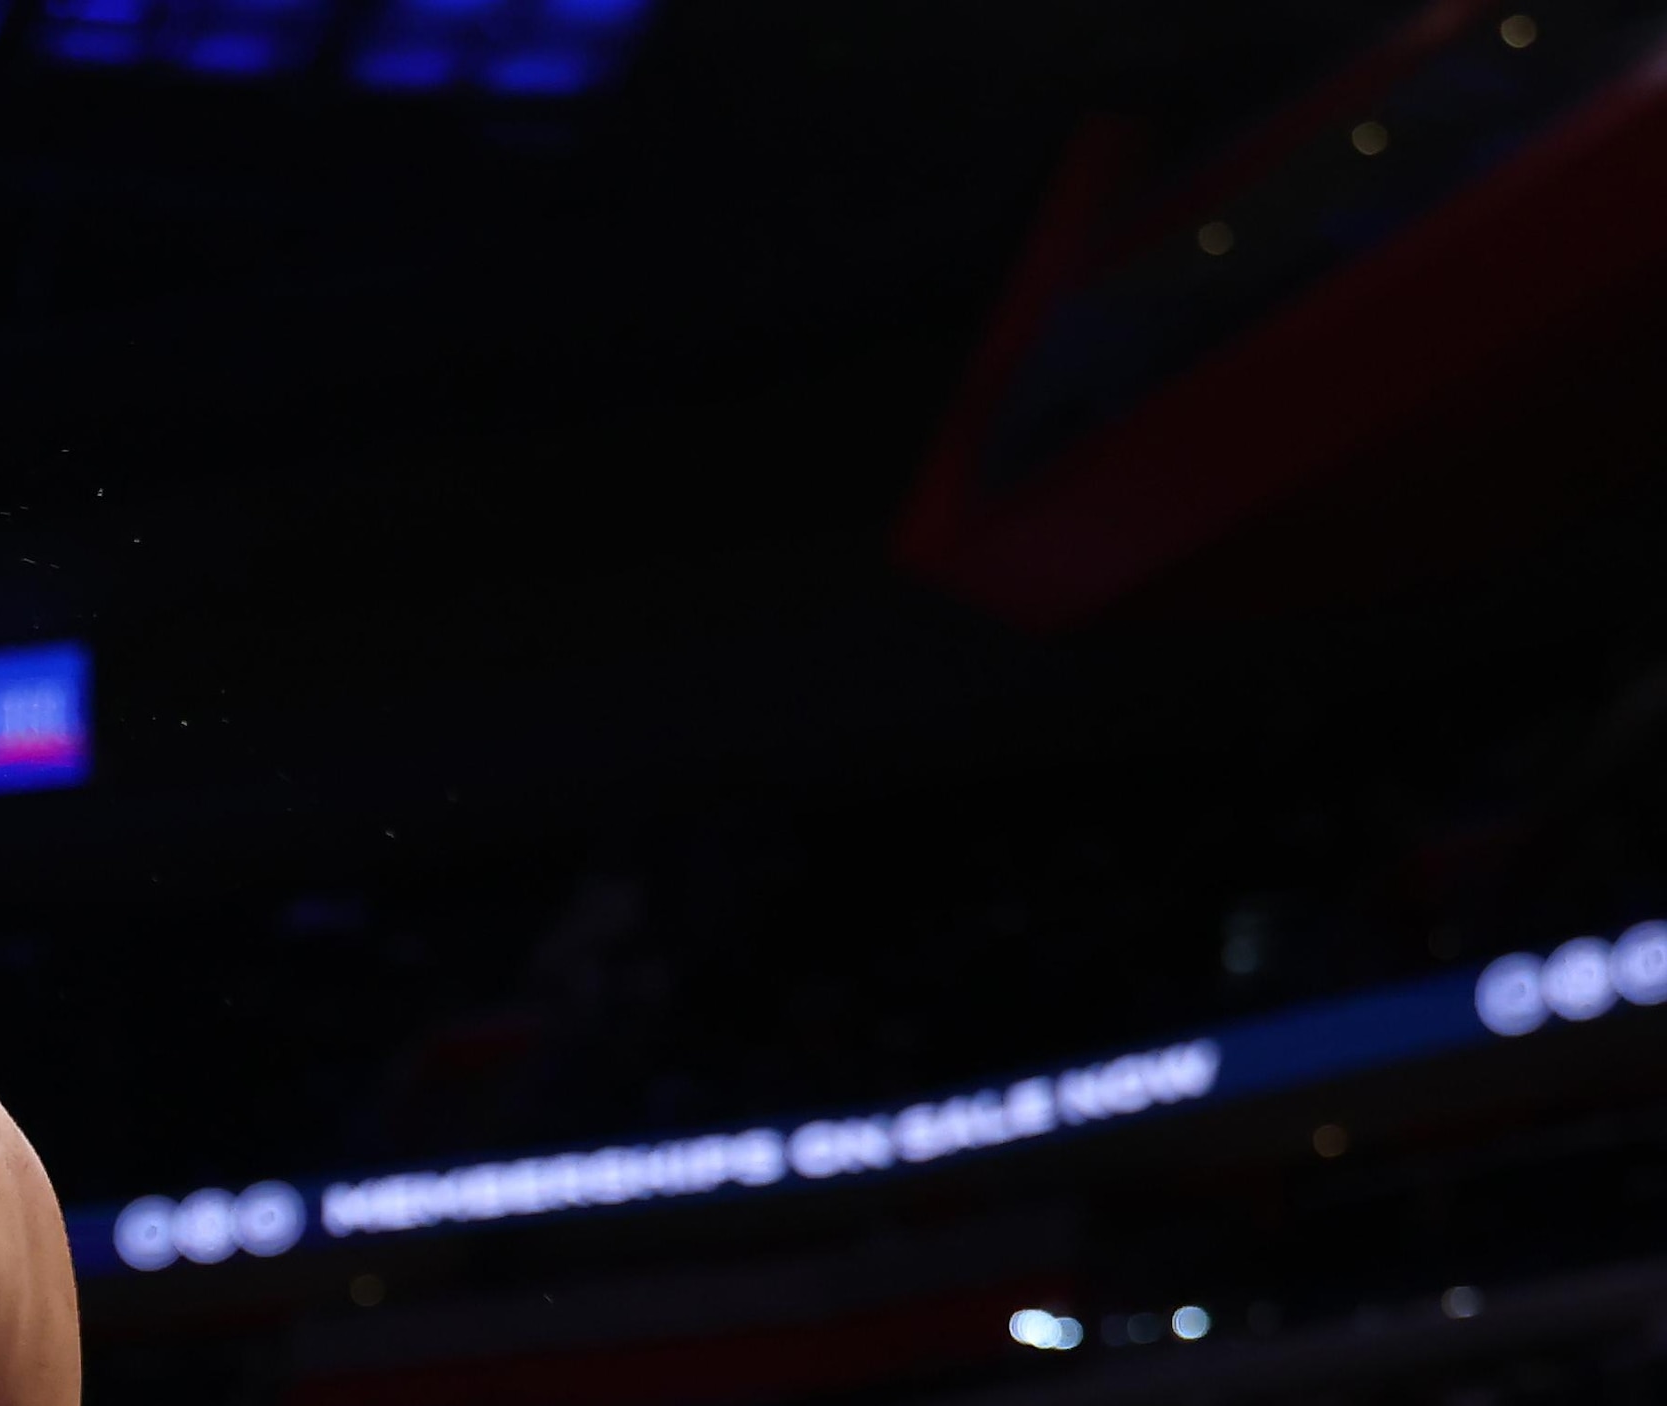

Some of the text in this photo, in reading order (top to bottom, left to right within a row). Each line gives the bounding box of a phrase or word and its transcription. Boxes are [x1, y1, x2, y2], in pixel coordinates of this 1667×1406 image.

[788, 1115, 895, 1180] ON
[896, 1076, 1055, 1162] SALE
[1057, 1040, 1220, 1124] NOW
